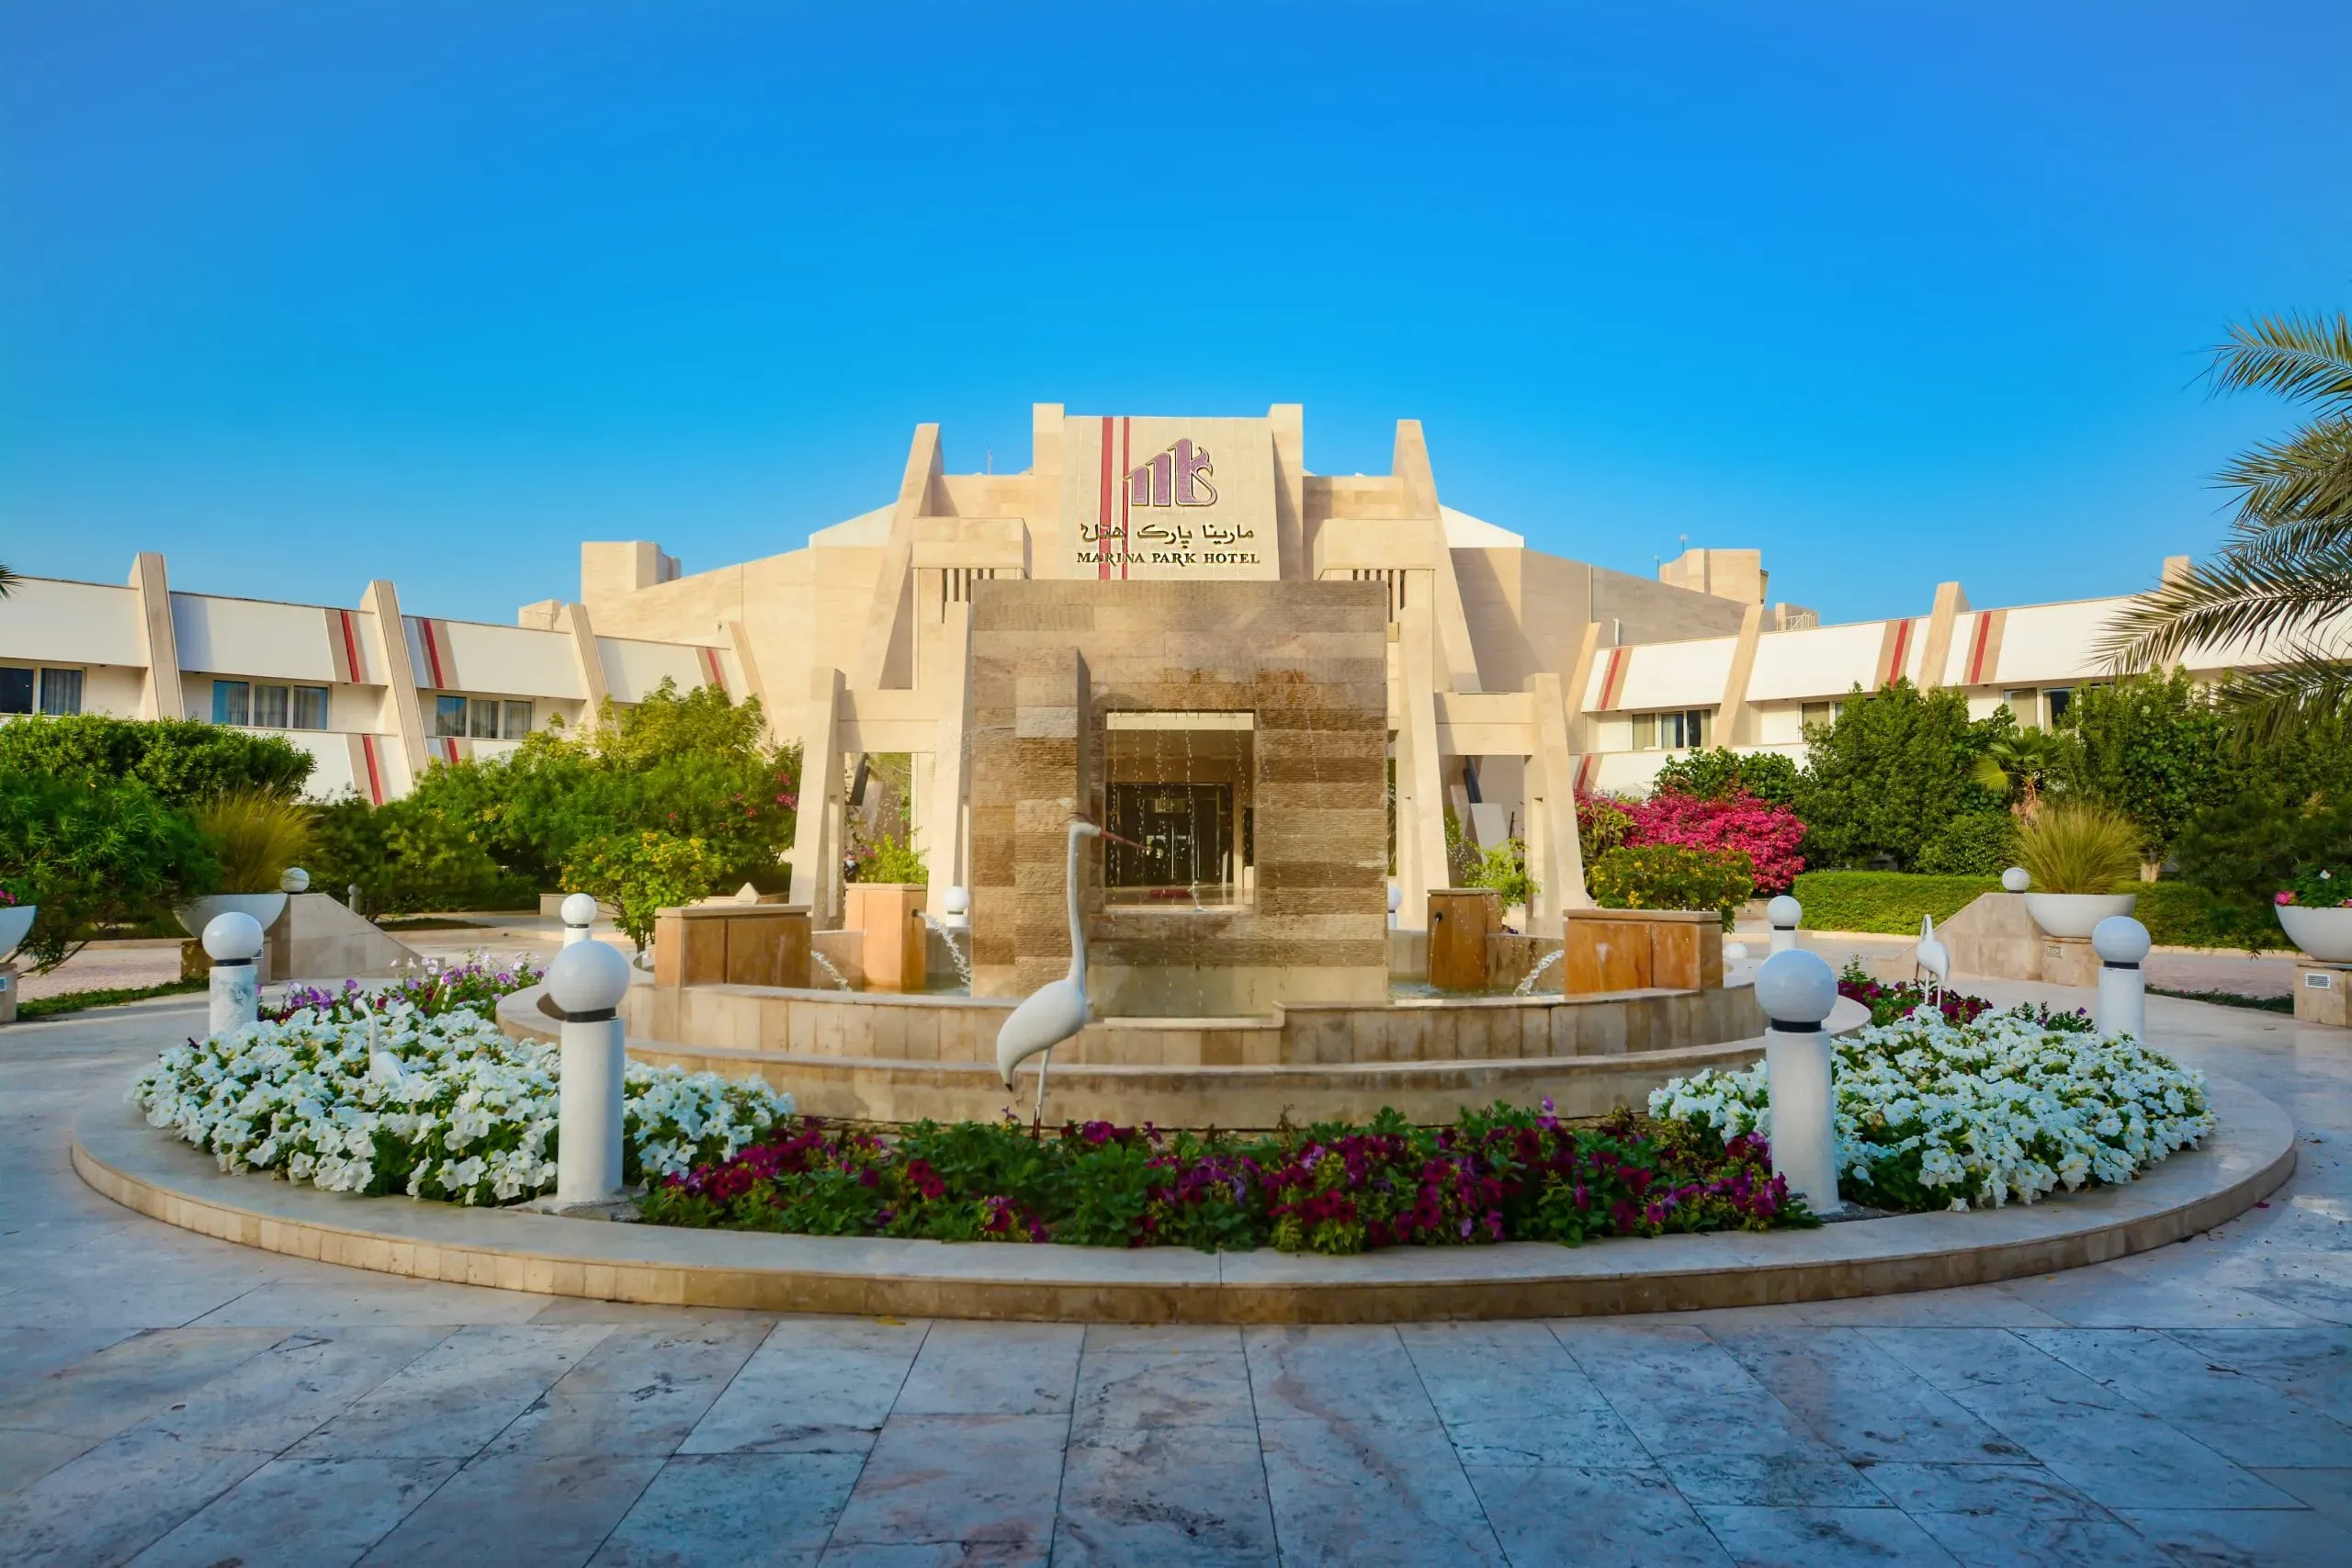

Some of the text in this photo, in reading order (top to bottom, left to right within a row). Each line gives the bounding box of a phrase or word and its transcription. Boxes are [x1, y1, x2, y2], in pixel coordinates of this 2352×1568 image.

[1077, 552, 1261, 567] MARINA PARK HOTEL
